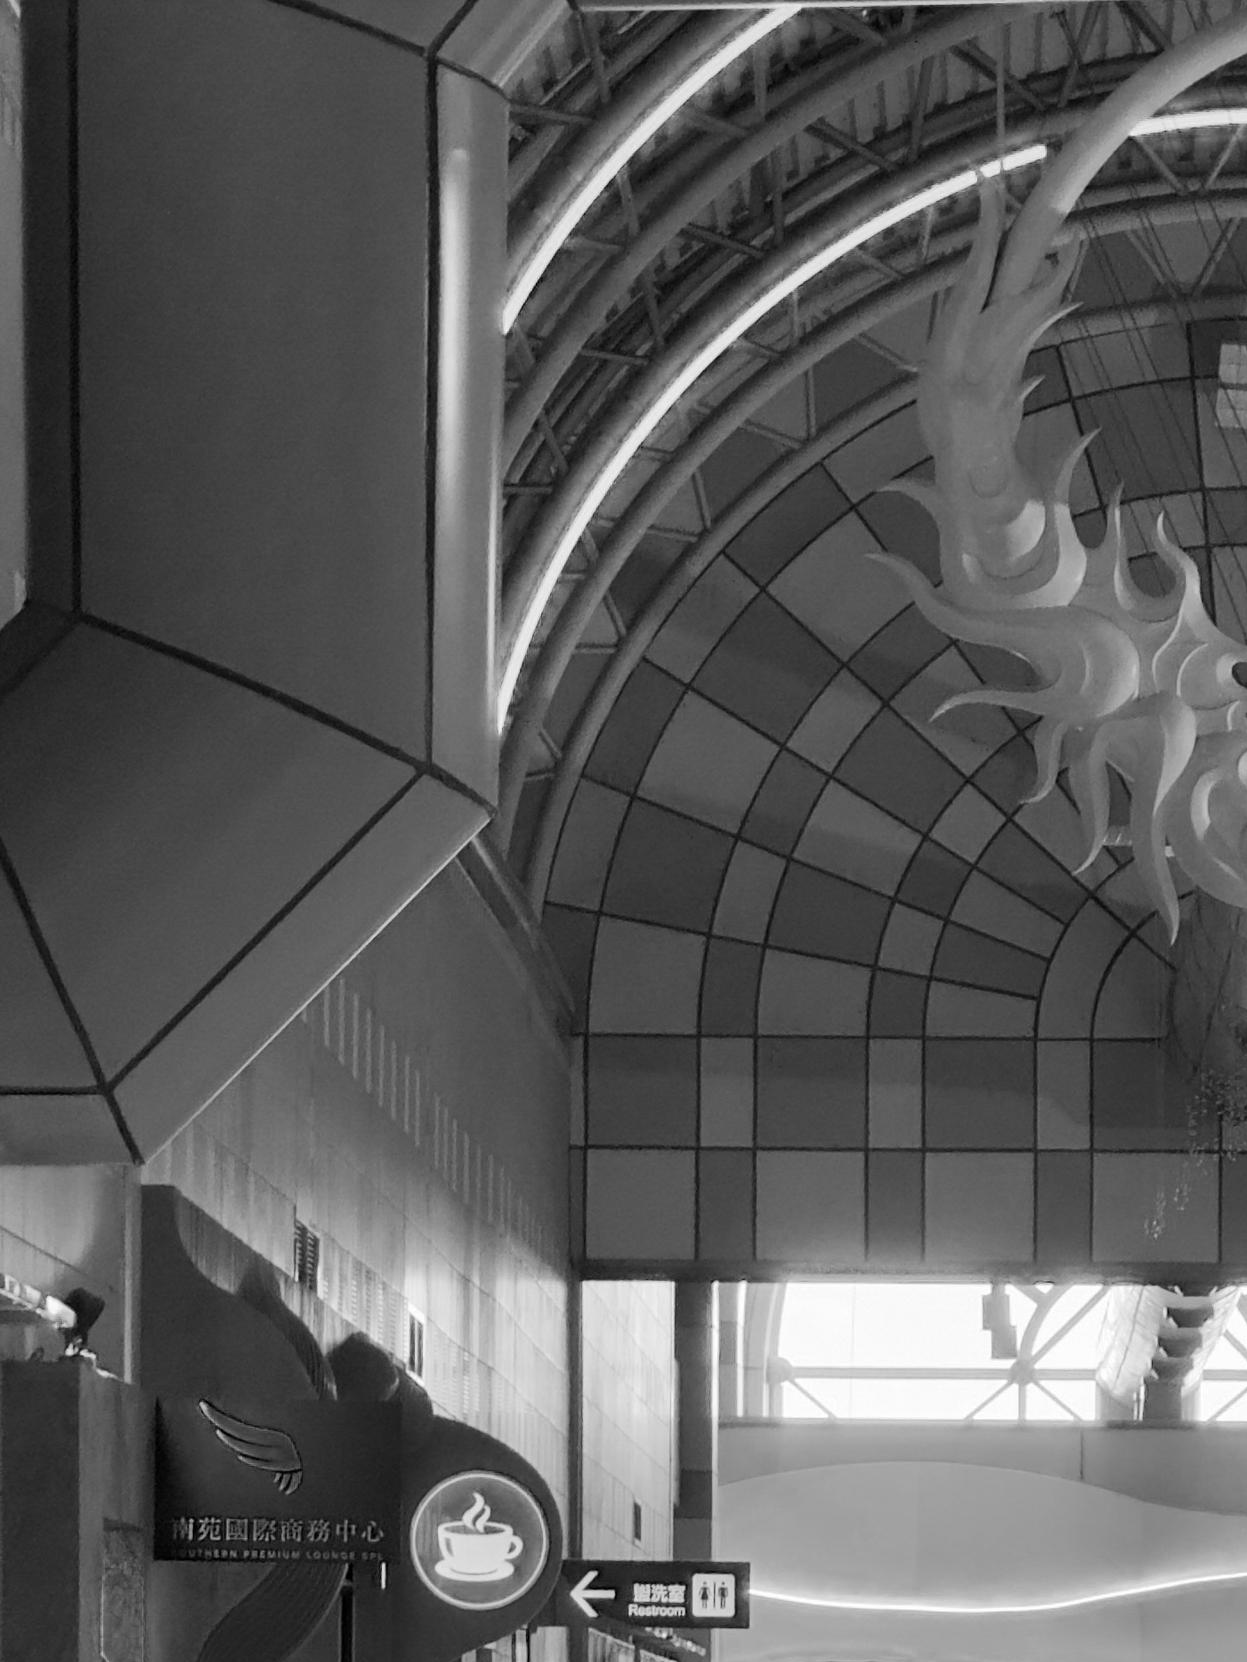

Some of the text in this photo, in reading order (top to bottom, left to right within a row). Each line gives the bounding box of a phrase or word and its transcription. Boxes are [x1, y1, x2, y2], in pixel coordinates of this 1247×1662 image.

[243, 1549, 300, 1560] PREMIUM
[306, 1550, 355, 1560] LOUNGE
[628, 1604, 686, 1617] Restroom
